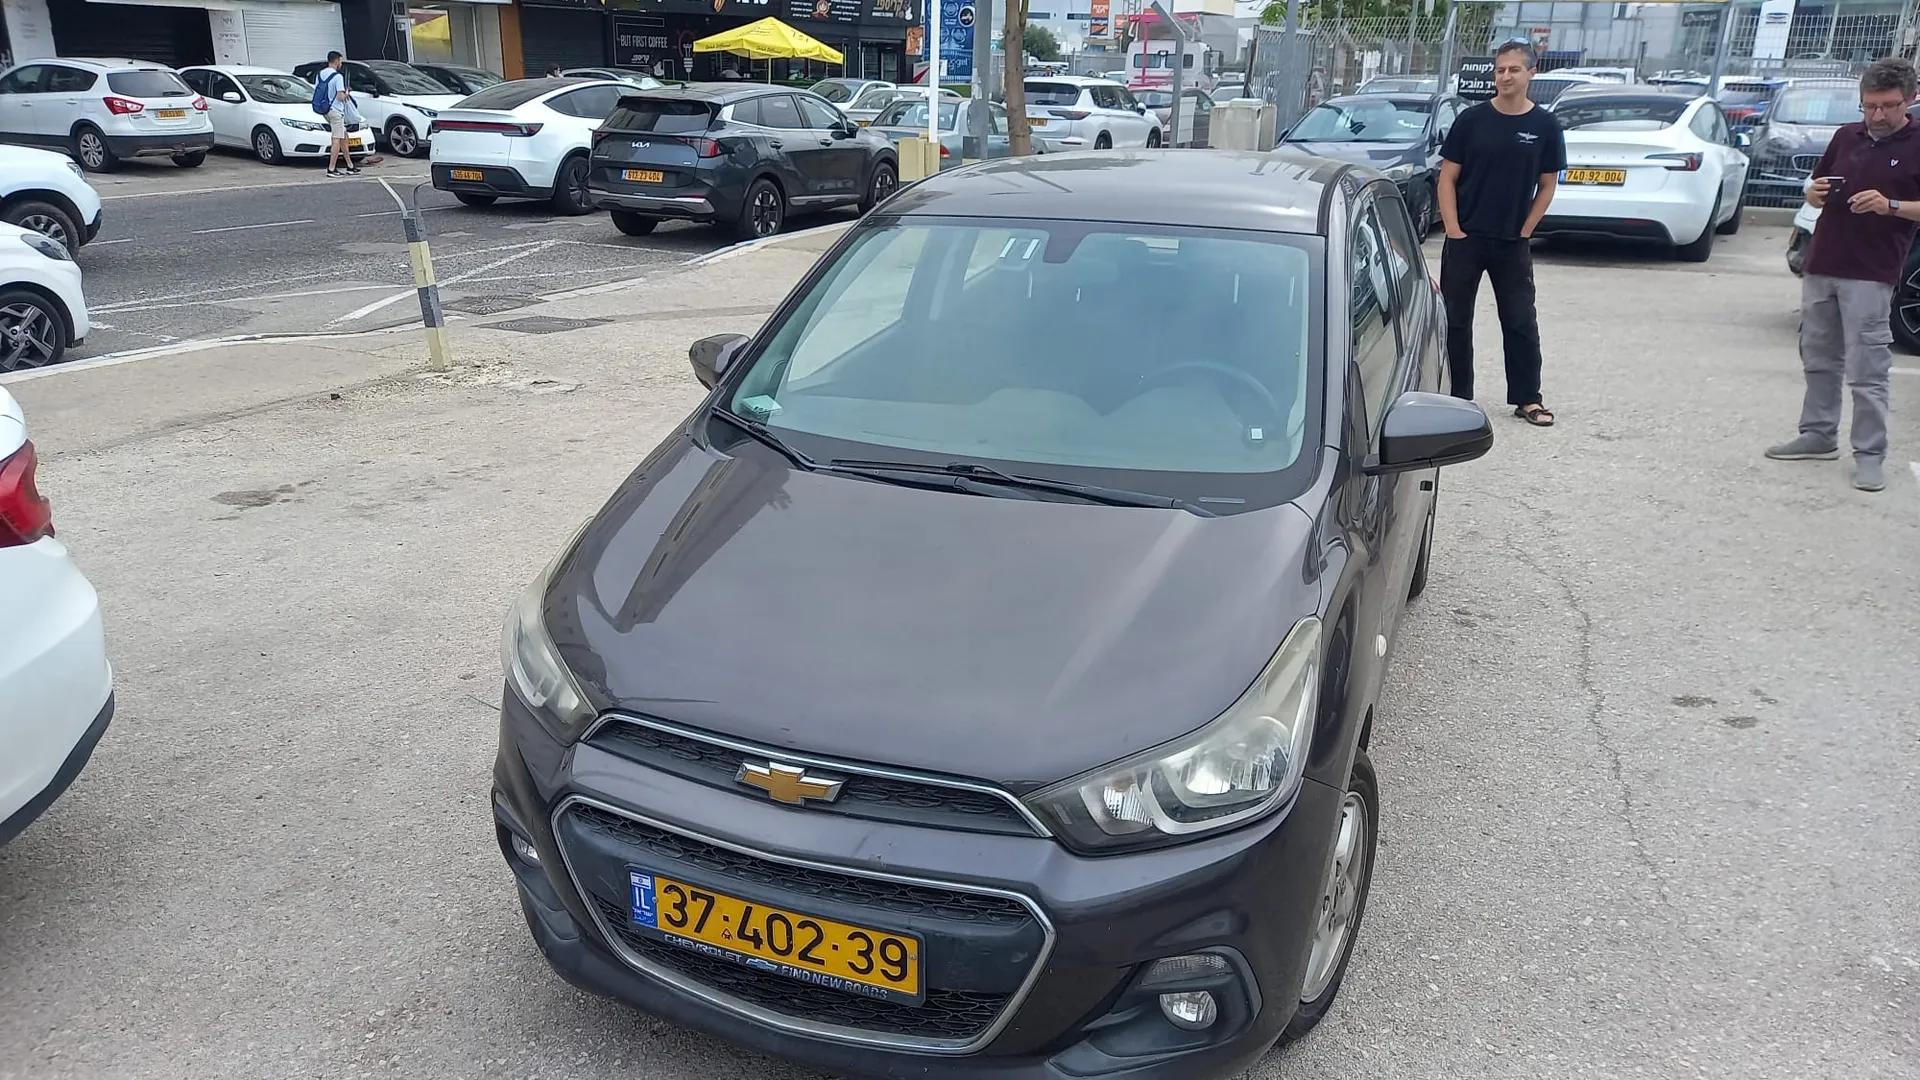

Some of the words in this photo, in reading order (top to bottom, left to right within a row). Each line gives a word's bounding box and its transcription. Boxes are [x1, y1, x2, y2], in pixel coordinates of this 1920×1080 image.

[620, 35, 631, 47] BUT
[632, 35, 647, 48] FIRST
[648, 36, 668, 49] COFFEE
[1462, 62, 1495, 74] לקוחות
[634, 886, 651, 911] IL
[664, 934, 742, 963] CHEVROLET
[780, 965, 811, 982] FIND
[812, 973, 844, 990] NEW
[844, 981, 889, 1000] ROADS
